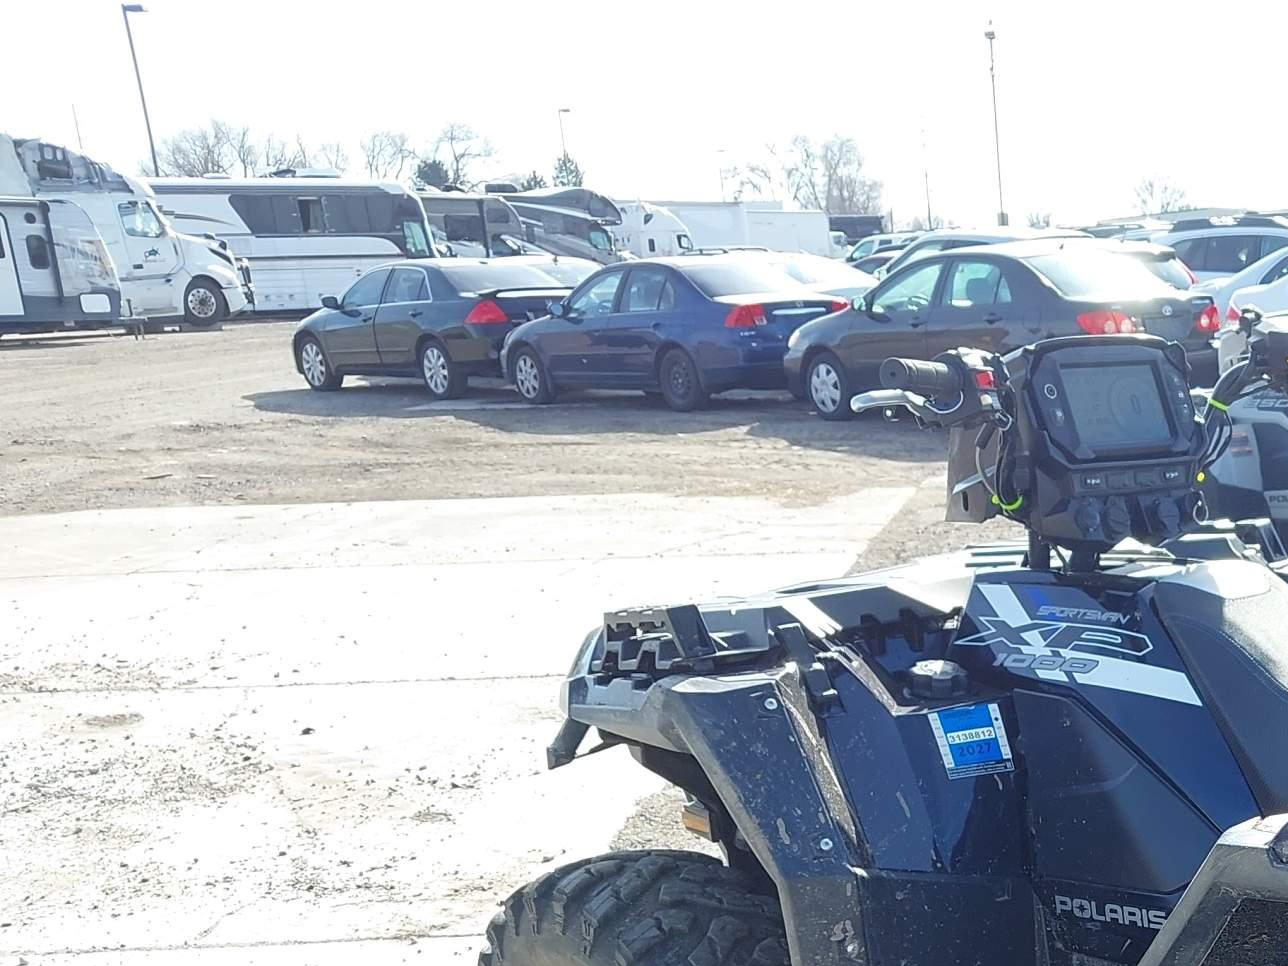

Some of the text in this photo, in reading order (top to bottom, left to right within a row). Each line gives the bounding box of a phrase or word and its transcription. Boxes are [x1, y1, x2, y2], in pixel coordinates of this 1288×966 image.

[1035, 605, 1131, 625] SPORTSMAN
[953, 616, 1154, 657] XP
[992, 652, 1101, 674] 1000
[948, 728, 994, 743] 3138812
[957, 742, 993, 758] 2027
[1054, 895, 1167, 930] POLARIS
